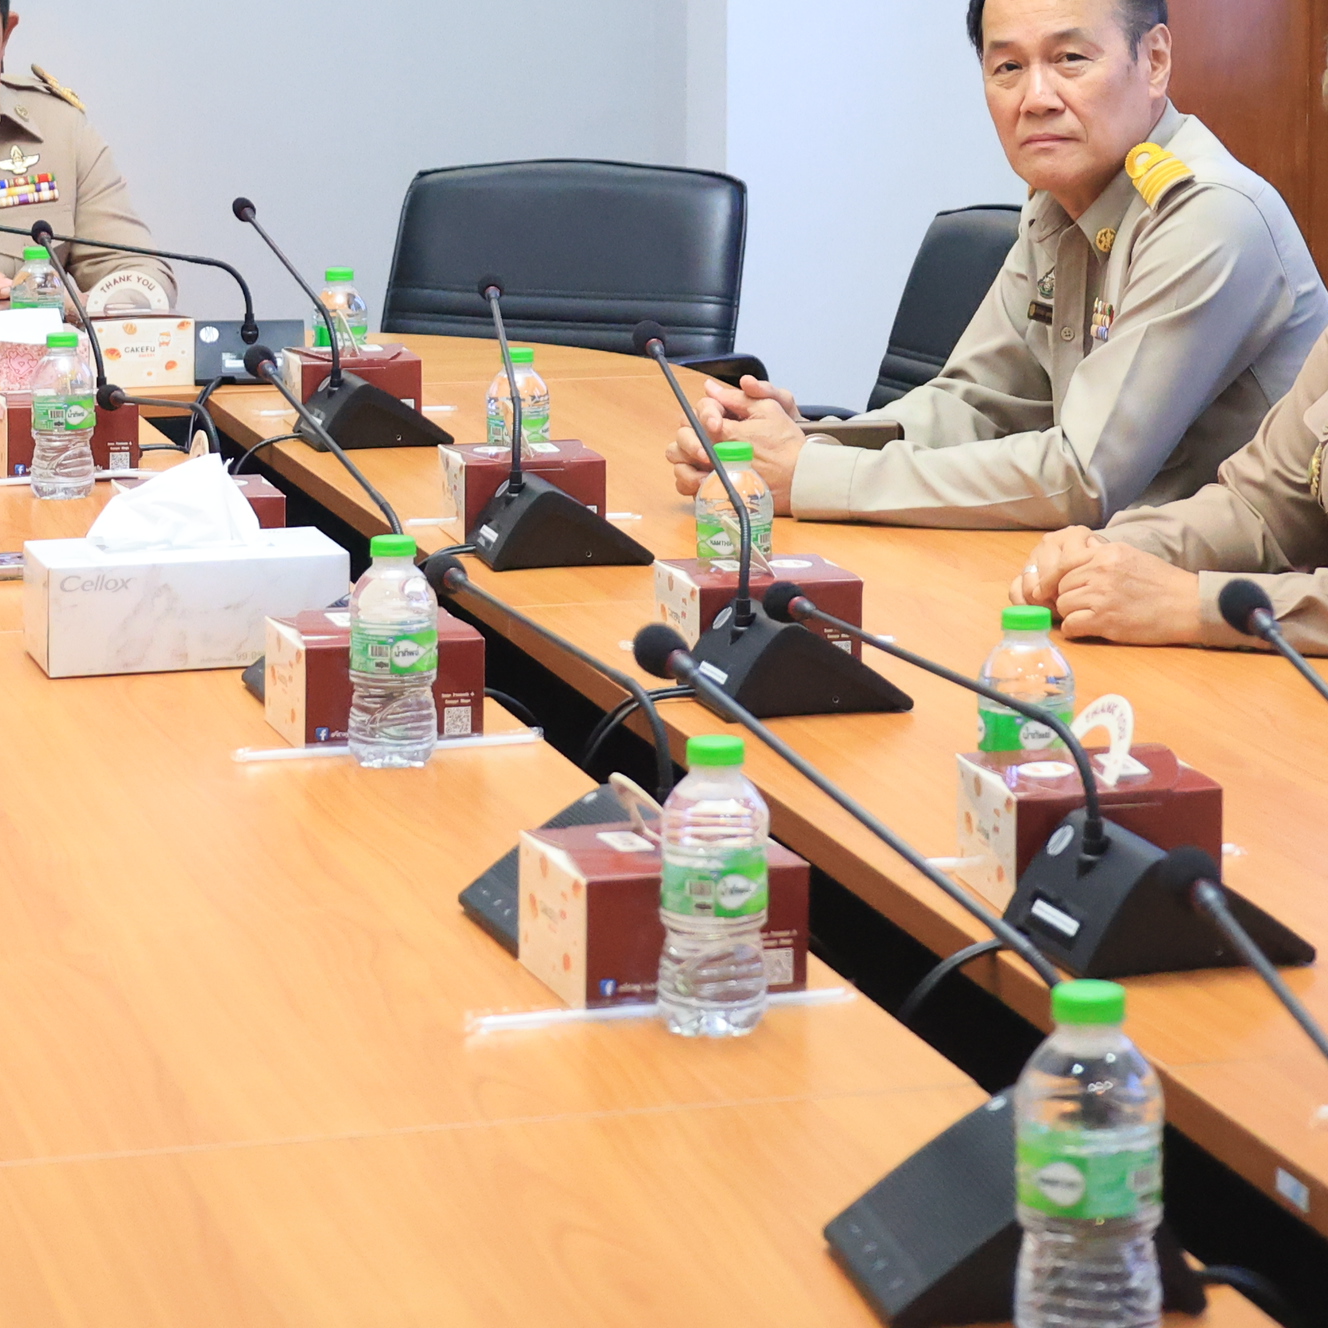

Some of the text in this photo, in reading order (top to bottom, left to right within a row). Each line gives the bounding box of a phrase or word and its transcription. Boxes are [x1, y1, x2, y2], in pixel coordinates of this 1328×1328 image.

[100, 274, 156, 293] THANK YOU
[124, 346, 156, 354] CAKEFU
[60, 574, 132, 593] Cellox
